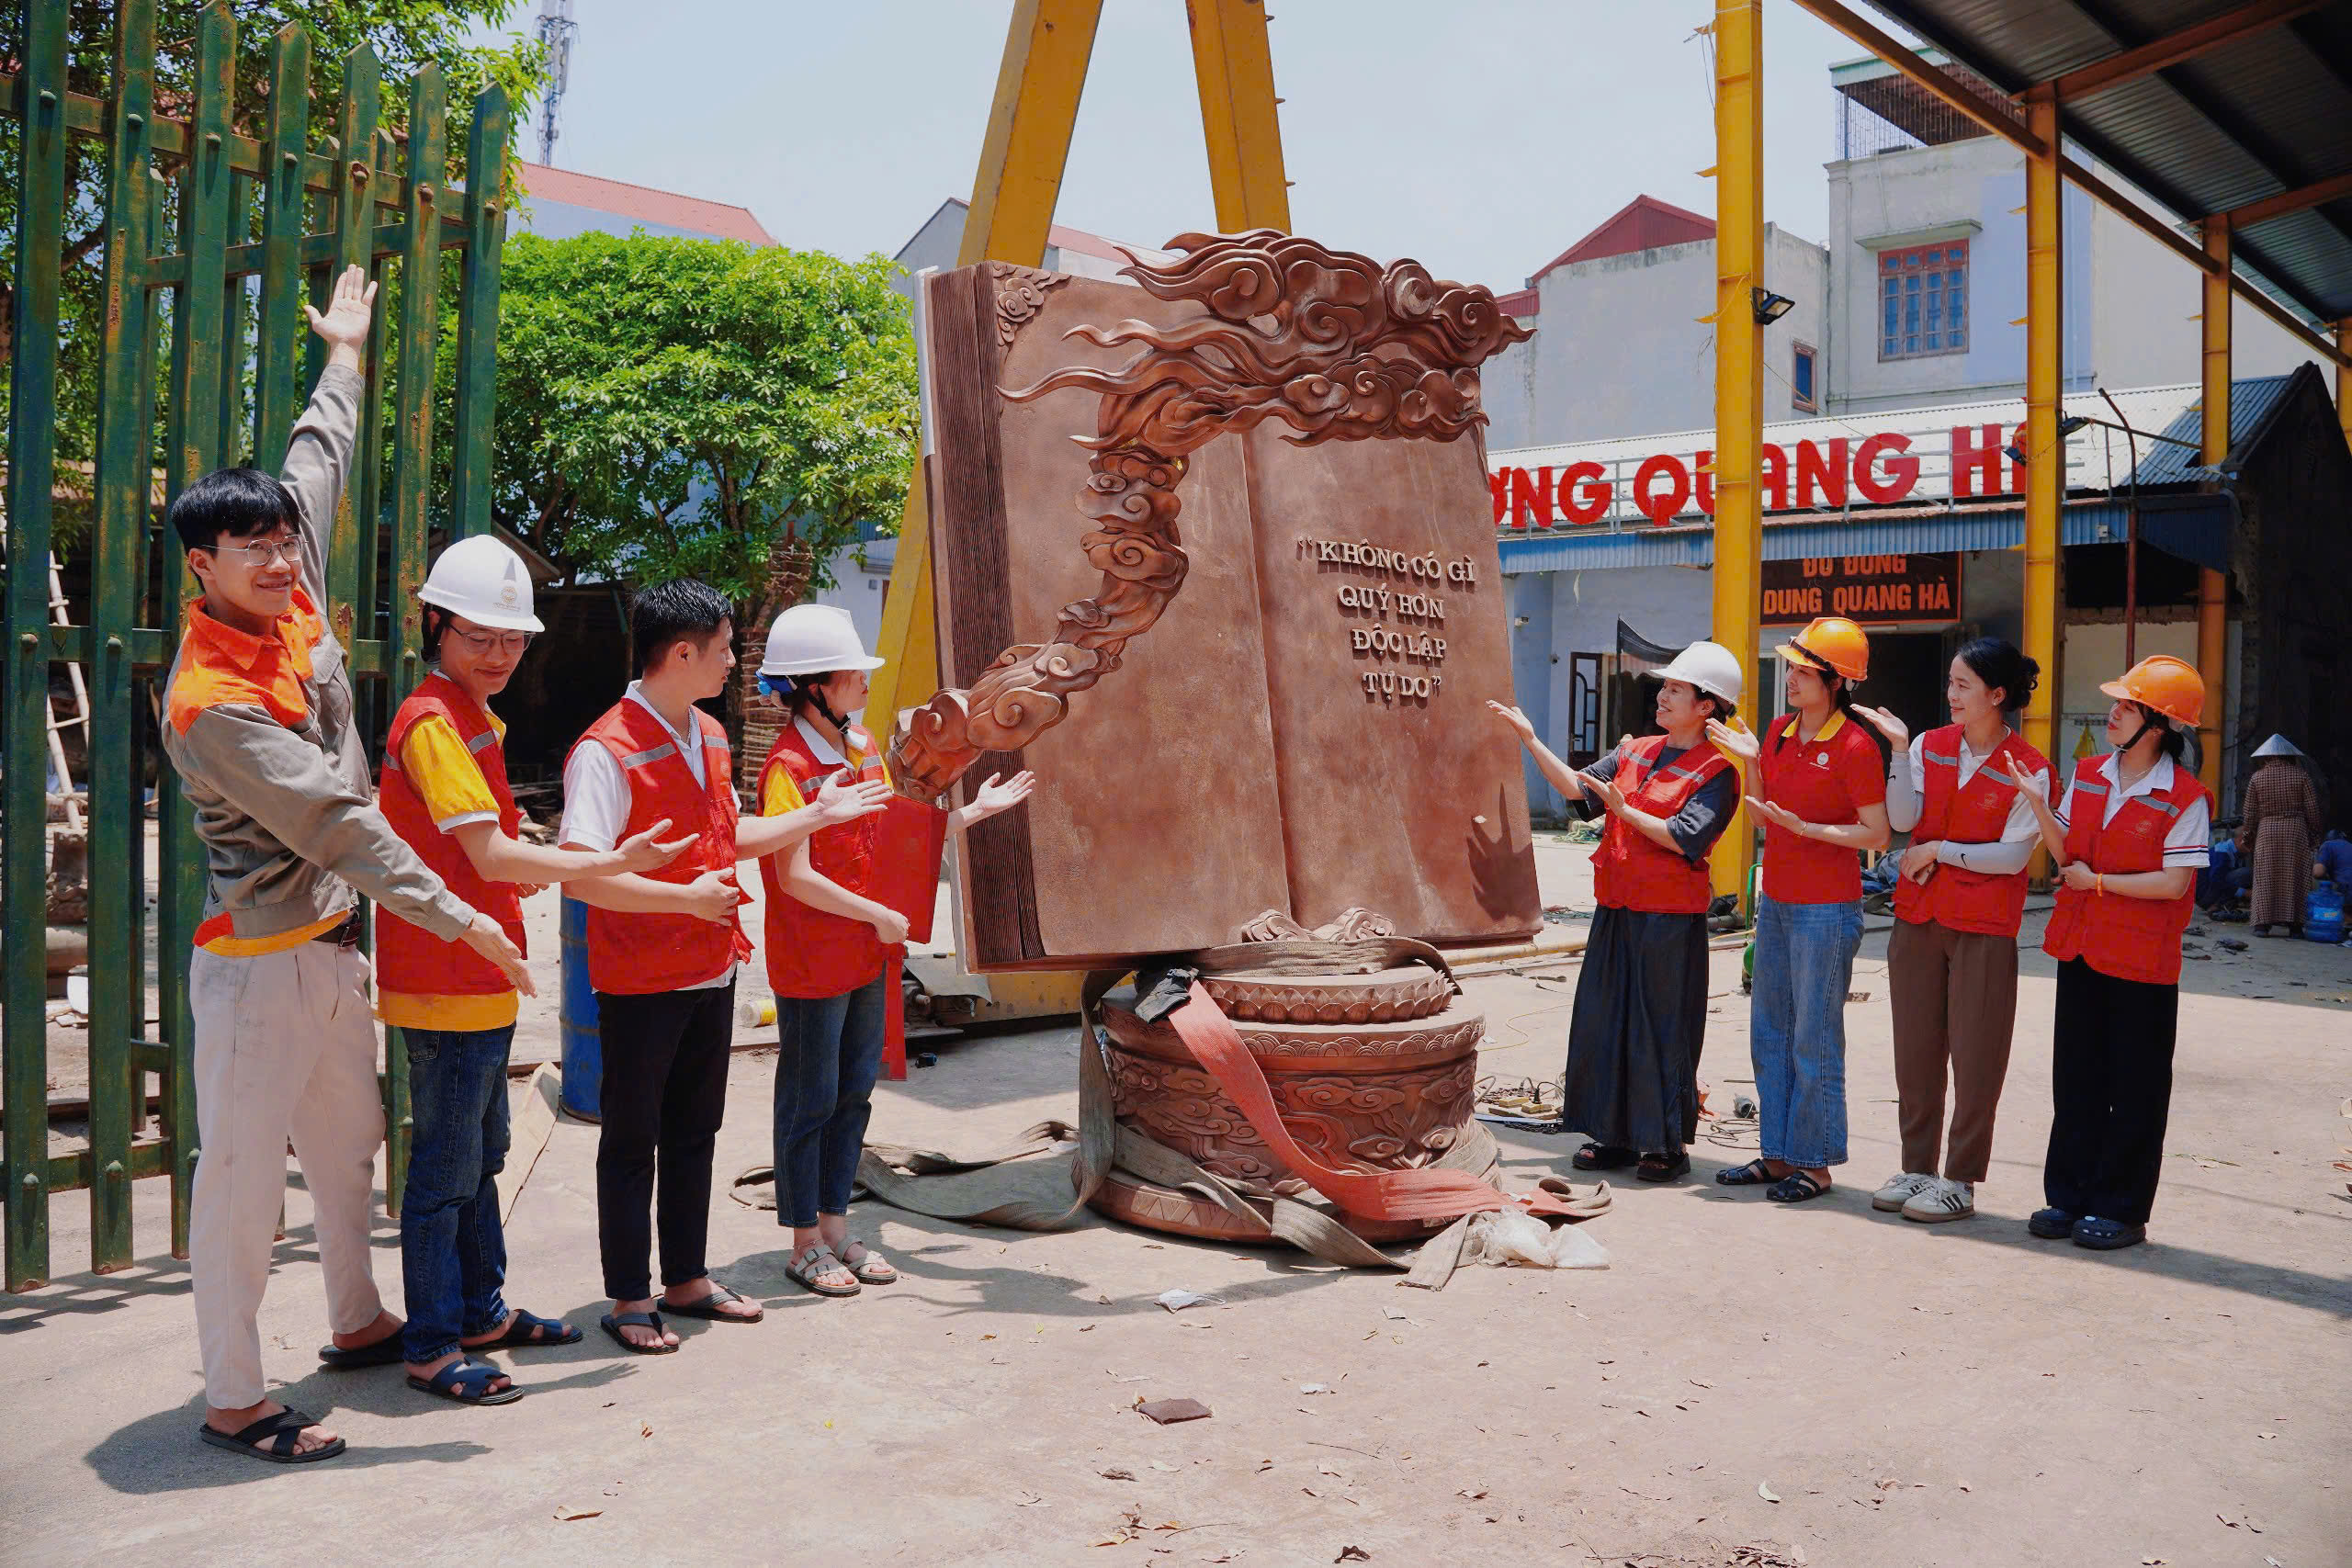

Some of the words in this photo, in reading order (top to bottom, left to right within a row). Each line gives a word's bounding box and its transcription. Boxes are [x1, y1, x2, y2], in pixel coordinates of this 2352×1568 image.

[1411, 551, 1442, 580] CÓ
[1447, 555, 1477, 582] GÌ
[1338, 582, 1391, 611] QUÝ
[1398, 593, 1446, 619] HƠN
[1833, 583, 1912, 615] QUANG
[1918, 575, 1951, 610] HÀ
[1351, 623, 1402, 656] ĐỘC
[1406, 631, 1448, 661] LẬP
[1363, 671, 1396, 701] TỰ
